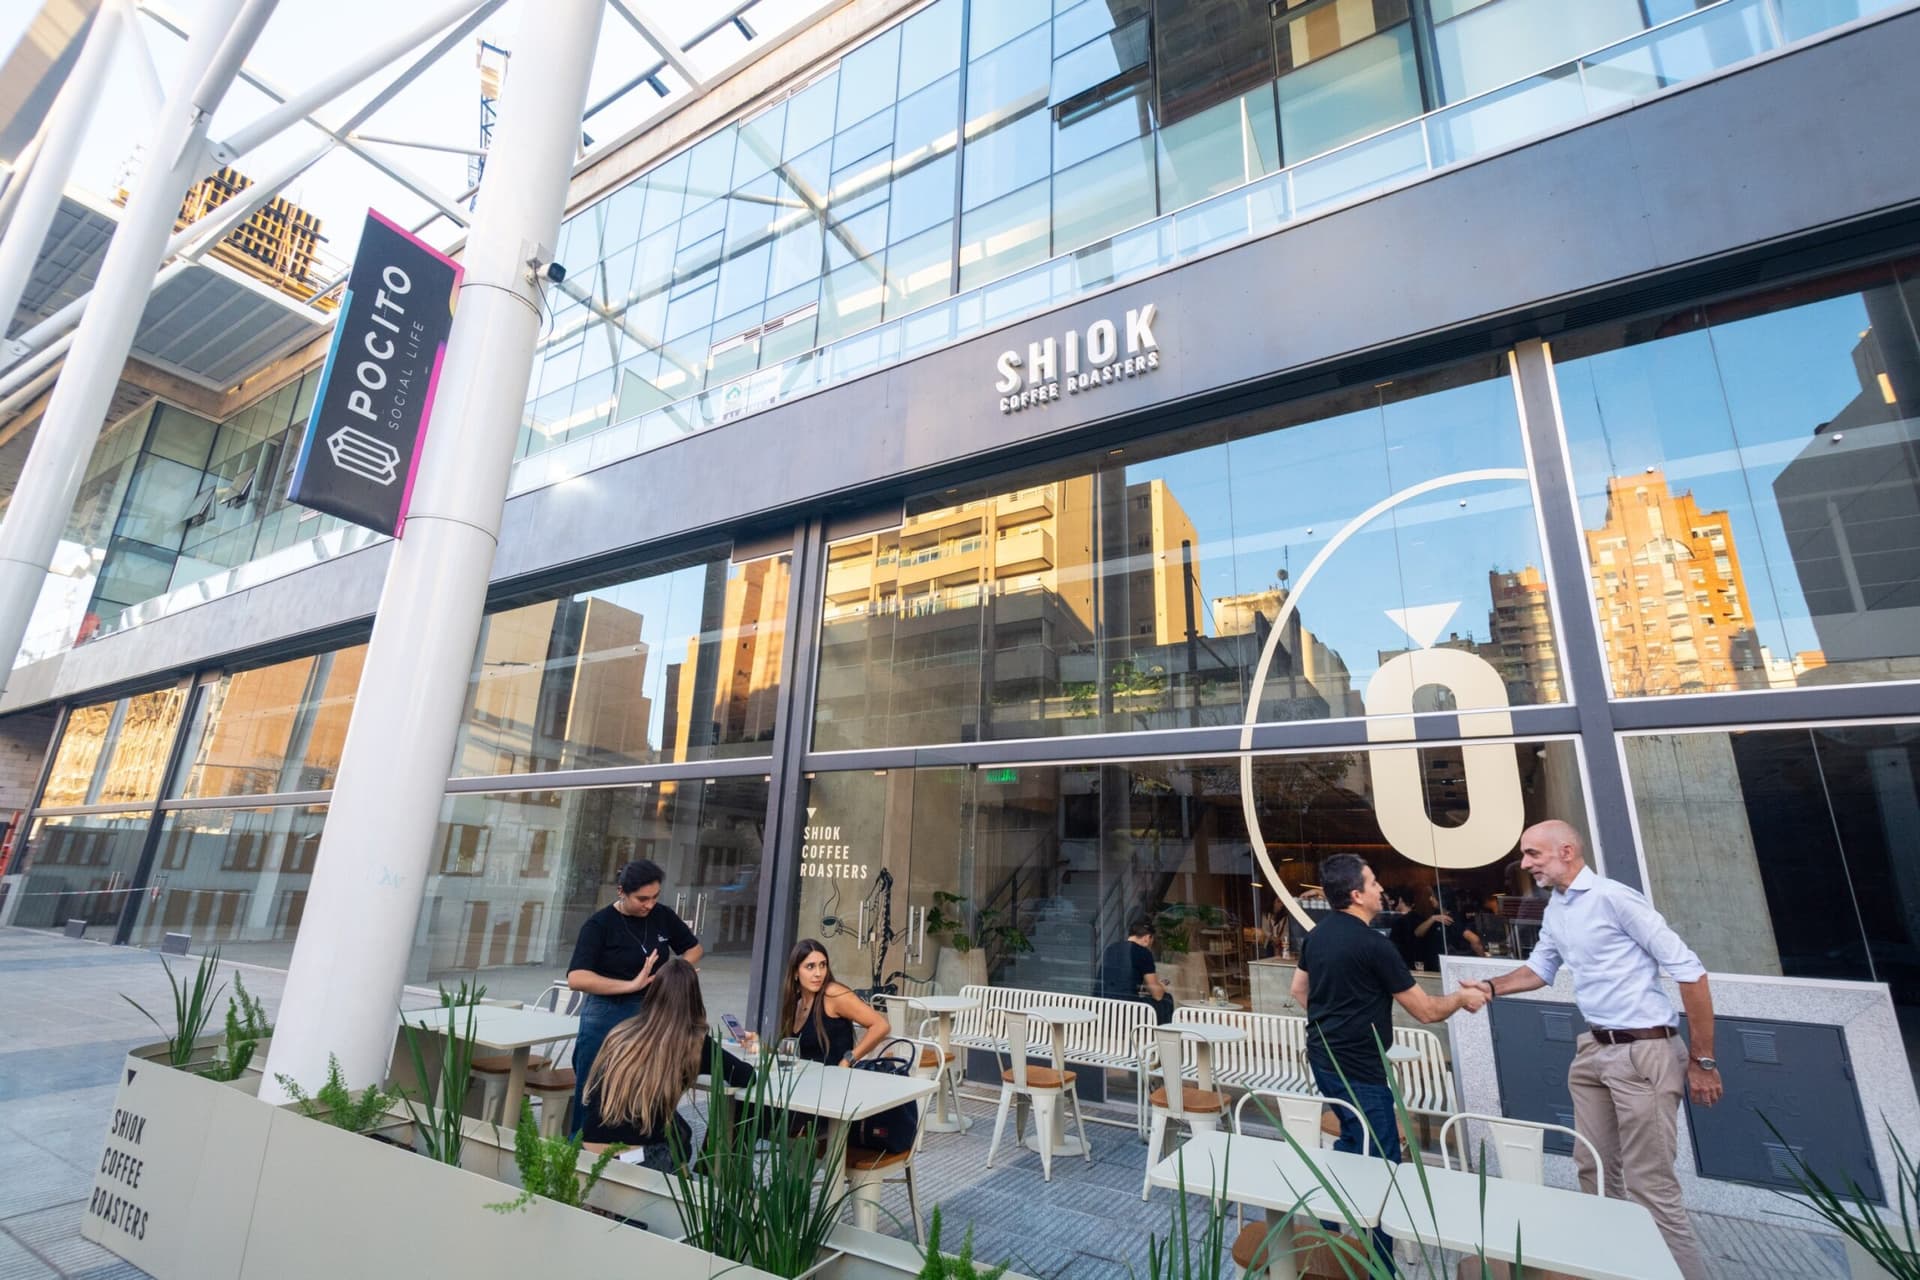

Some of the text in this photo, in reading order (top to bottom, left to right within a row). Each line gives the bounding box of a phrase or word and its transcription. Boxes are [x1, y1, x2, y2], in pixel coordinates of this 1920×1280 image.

[347, 265, 412, 421] POCITO
[995, 303, 1160, 395] SHIOK
[388, 320, 424, 430] SOCIAL LIFE
[1000, 351, 1159, 414] COFFEE ROASTERS
[801, 844, 850, 860] COFFEE
[803, 826, 841, 840] SHIOK
[800, 862, 868, 879] ROASTERS
[111, 1108, 147, 1145] SHIOK
[101, 1147, 144, 1189] COFFEE
[89, 1186, 149, 1241] ROASTERS
